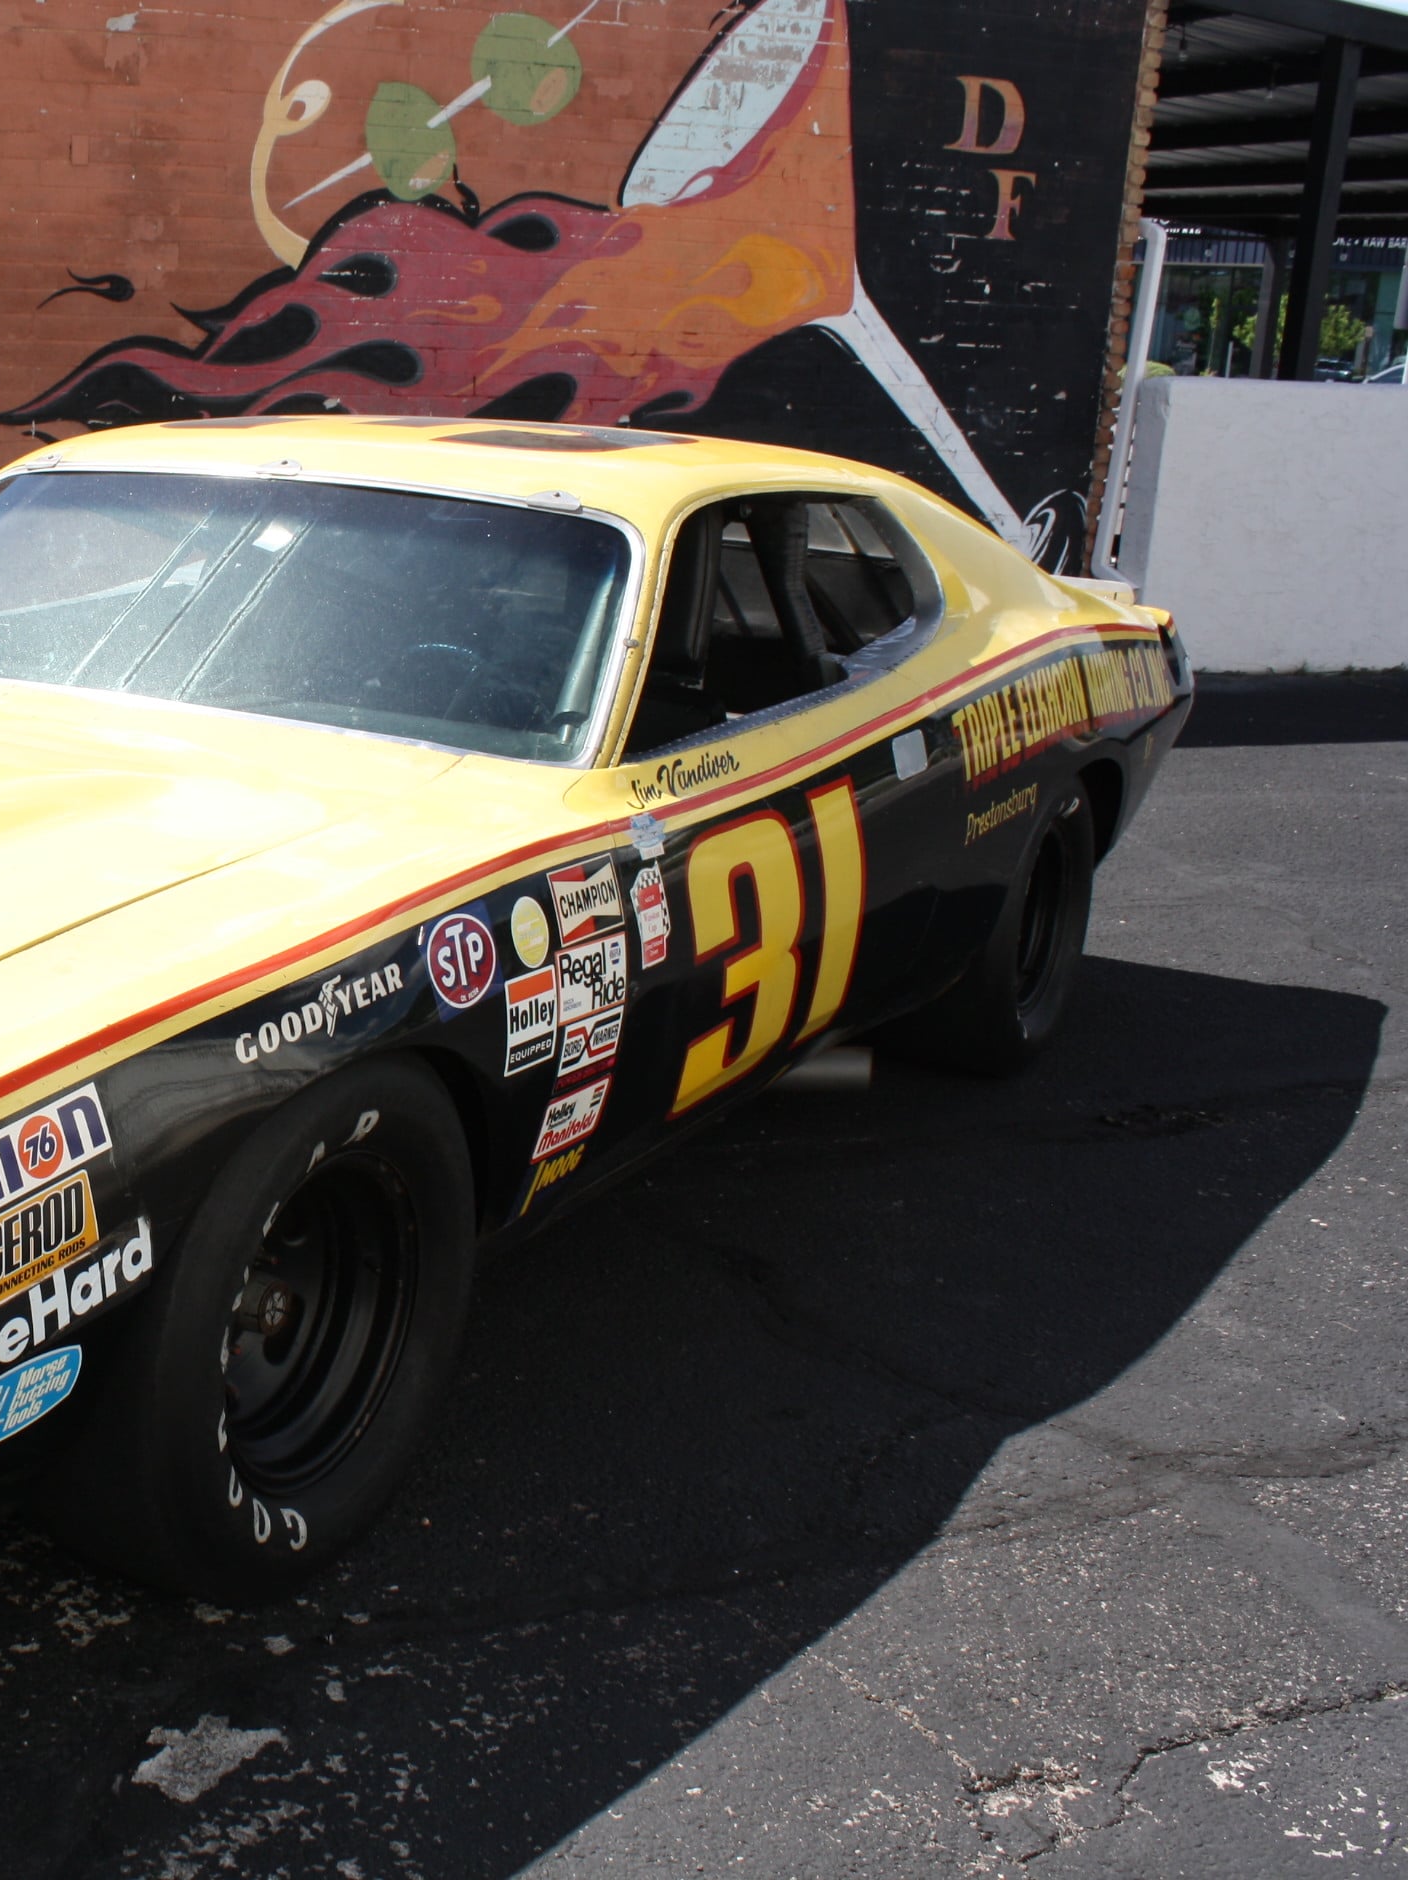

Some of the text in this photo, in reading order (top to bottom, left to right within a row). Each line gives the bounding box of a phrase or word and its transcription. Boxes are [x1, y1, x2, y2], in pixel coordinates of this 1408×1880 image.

[943, 75, 1026, 155] D
[984, 168, 1037, 241] F
[951, 684, 1021, 783] TRIPLE
[1014, 655, 1089, 754] ELKHORN
[626, 750, 741, 810] Jim Vandiver
[963, 782, 1040, 848] Prestonsburg
[559, 881, 617, 919] CHAMPION
[437, 921, 485, 988] STP
[558, 941, 607, 989] Regal
[665, 774, 867, 1123] 31
[234, 962, 404, 1065] GOODYEAR
[591, 970, 626, 1010] Ride
[509, 998, 555, 1035] Holley
[592, 1023, 620, 1047] WARNER
[509, 1038, 553, 1064] EQUIPPED
[546, 1099, 577, 1126] Holley
[23, 1121, 58, 1171] 76
[534, 1143, 586, 1193] MOOG
[58, 1236, 86, 1261] RODS
[9, 1368, 72, 1412] Cutting
[16, 1353, 70, 1393] Morse
[3, 1399, 44, 1432] Tools
